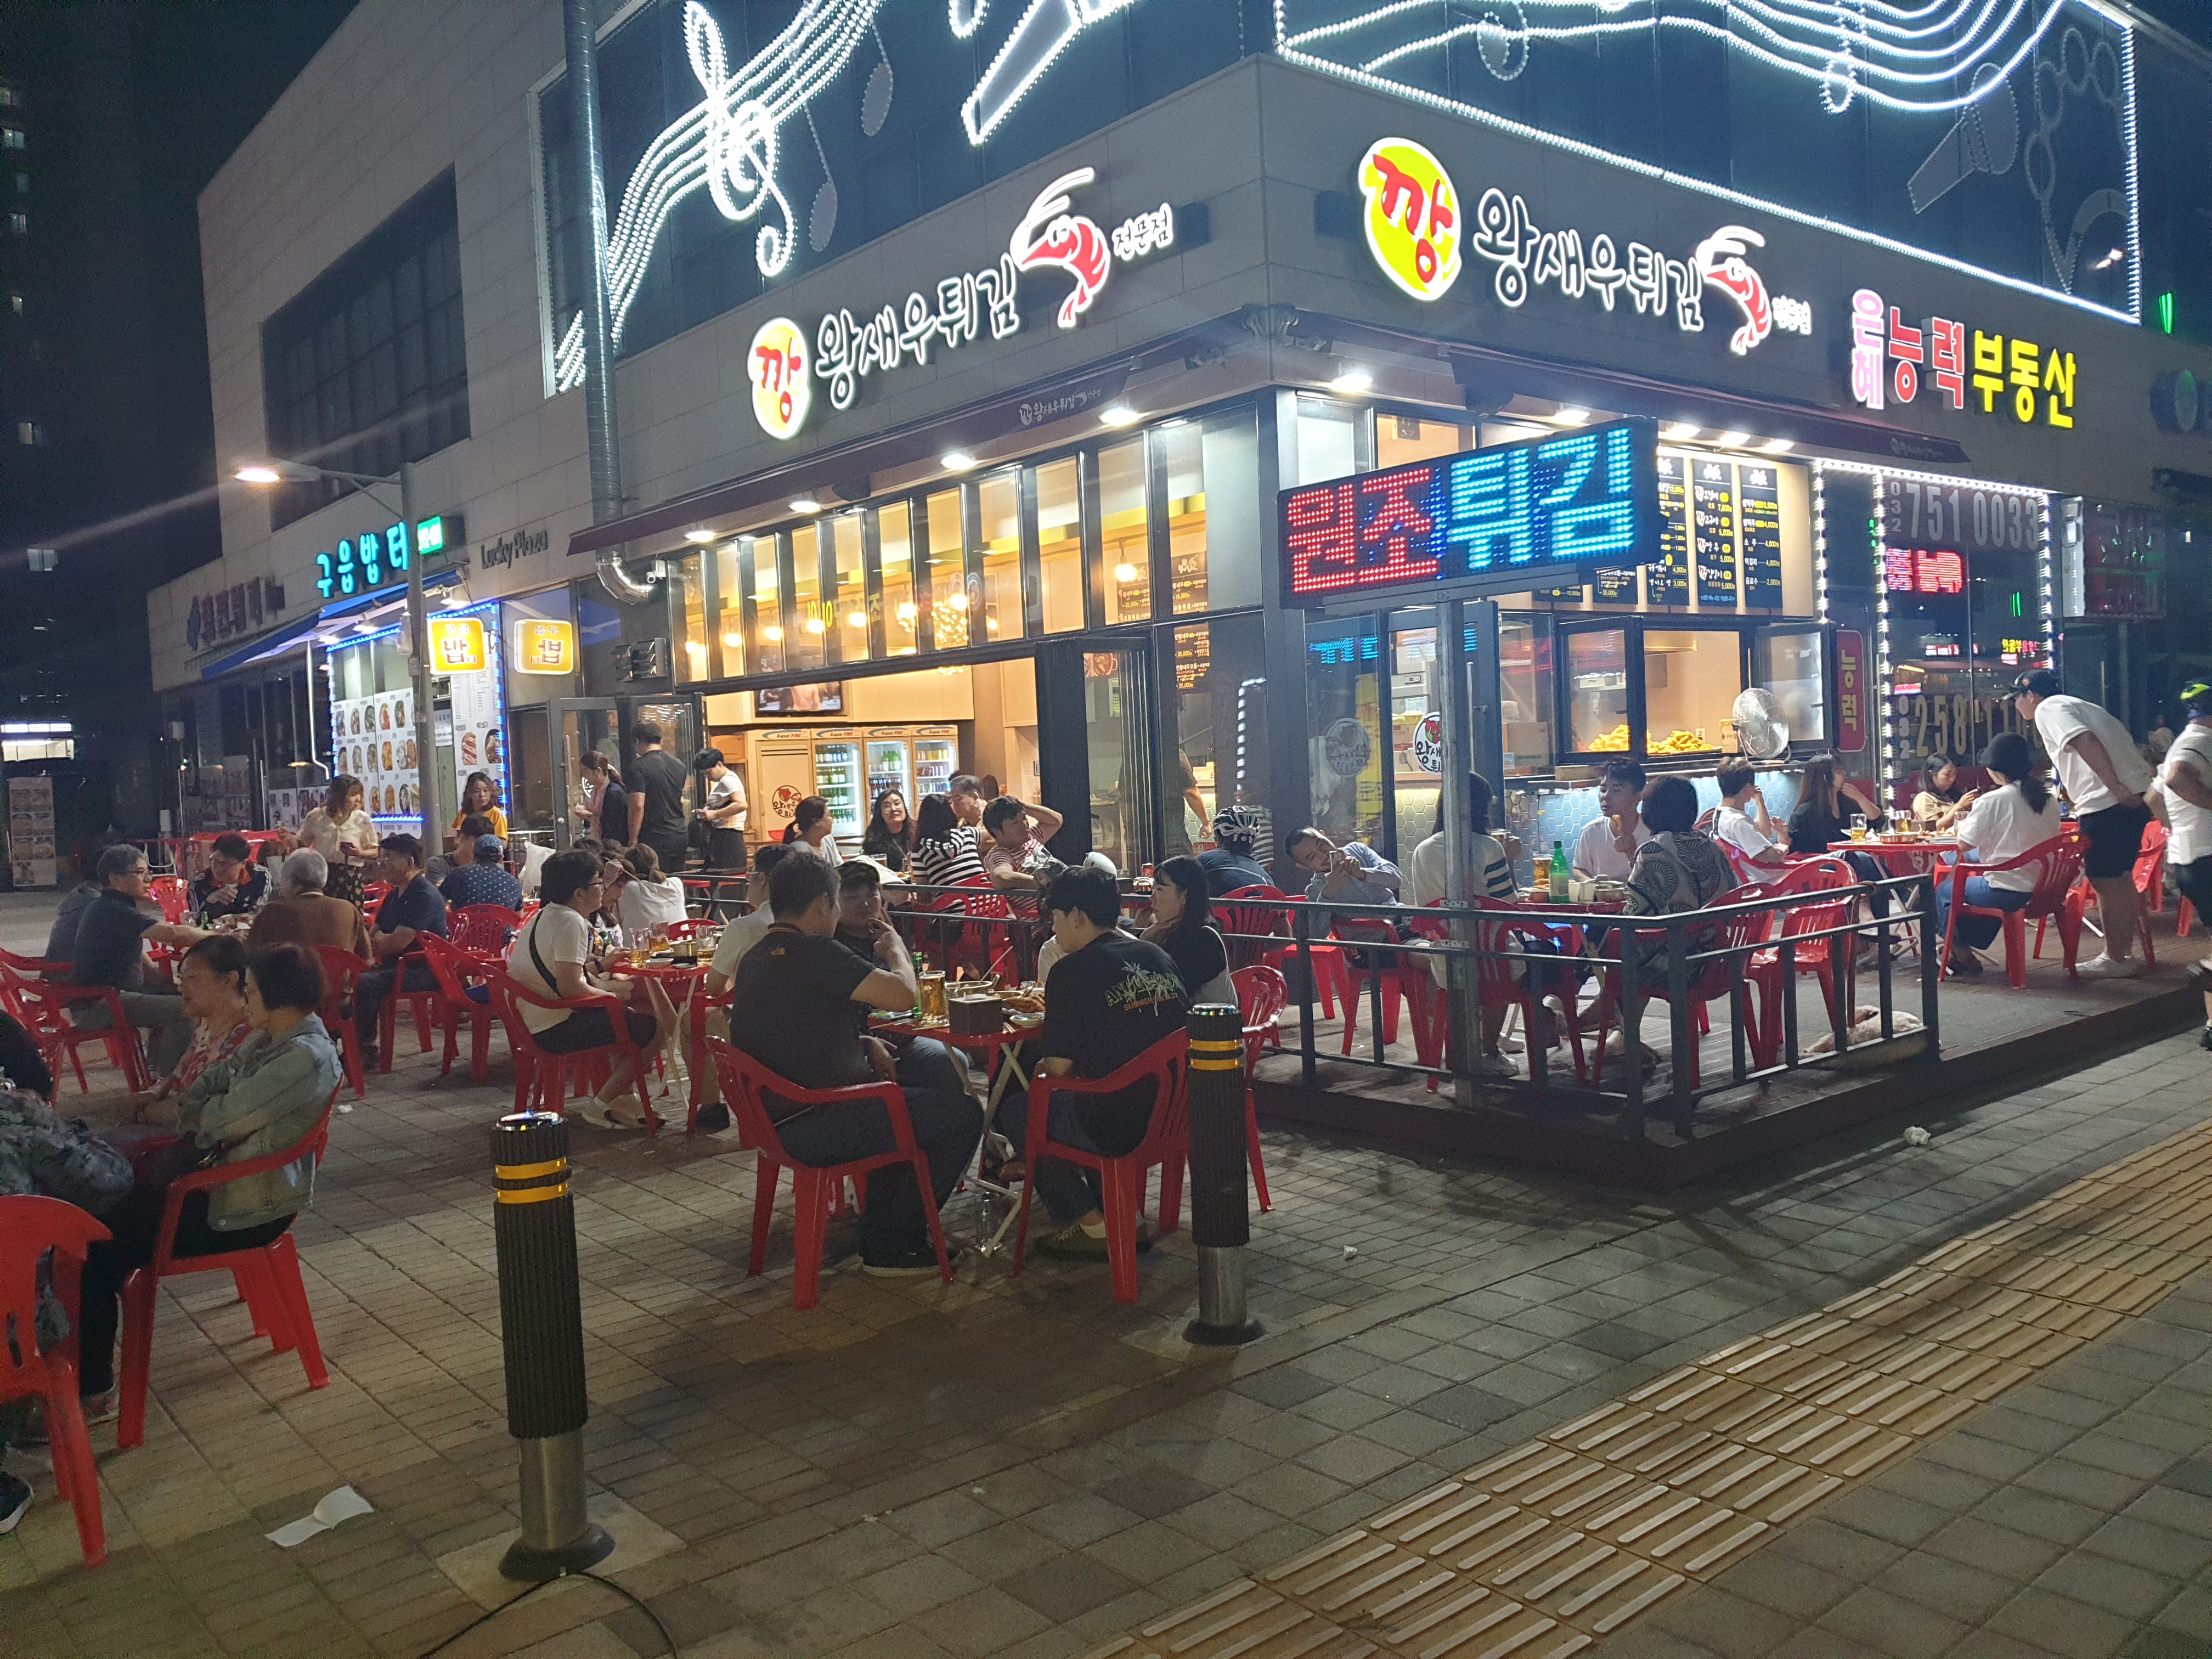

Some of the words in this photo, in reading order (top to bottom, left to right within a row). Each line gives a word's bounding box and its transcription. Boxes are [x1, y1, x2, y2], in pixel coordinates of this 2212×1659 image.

[1373, 154, 1454, 283] 깡
[1474, 188, 1704, 332] 왕새우튀김
[755, 335, 802, 425] 깡
[815, 253, 1019, 410] 왕새우튀김
[1113, 202, 1175, 262] 전문점
[1889, 306, 1965, 410] 능력
[1973, 330, 2076, 429] 부동산
[481, 537, 513, 569] Lucky
[514, 529, 548, 558] Plaza
[1287, 467, 1438, 594] 원조
[1447, 427, 1635, 569] 튀김
[1906, 483, 1961, 542] 751
[317, 520, 409, 599] 구읍밥터
[1841, 649, 1857, 731] 능력
[1915, 694, 1966, 757] 258
